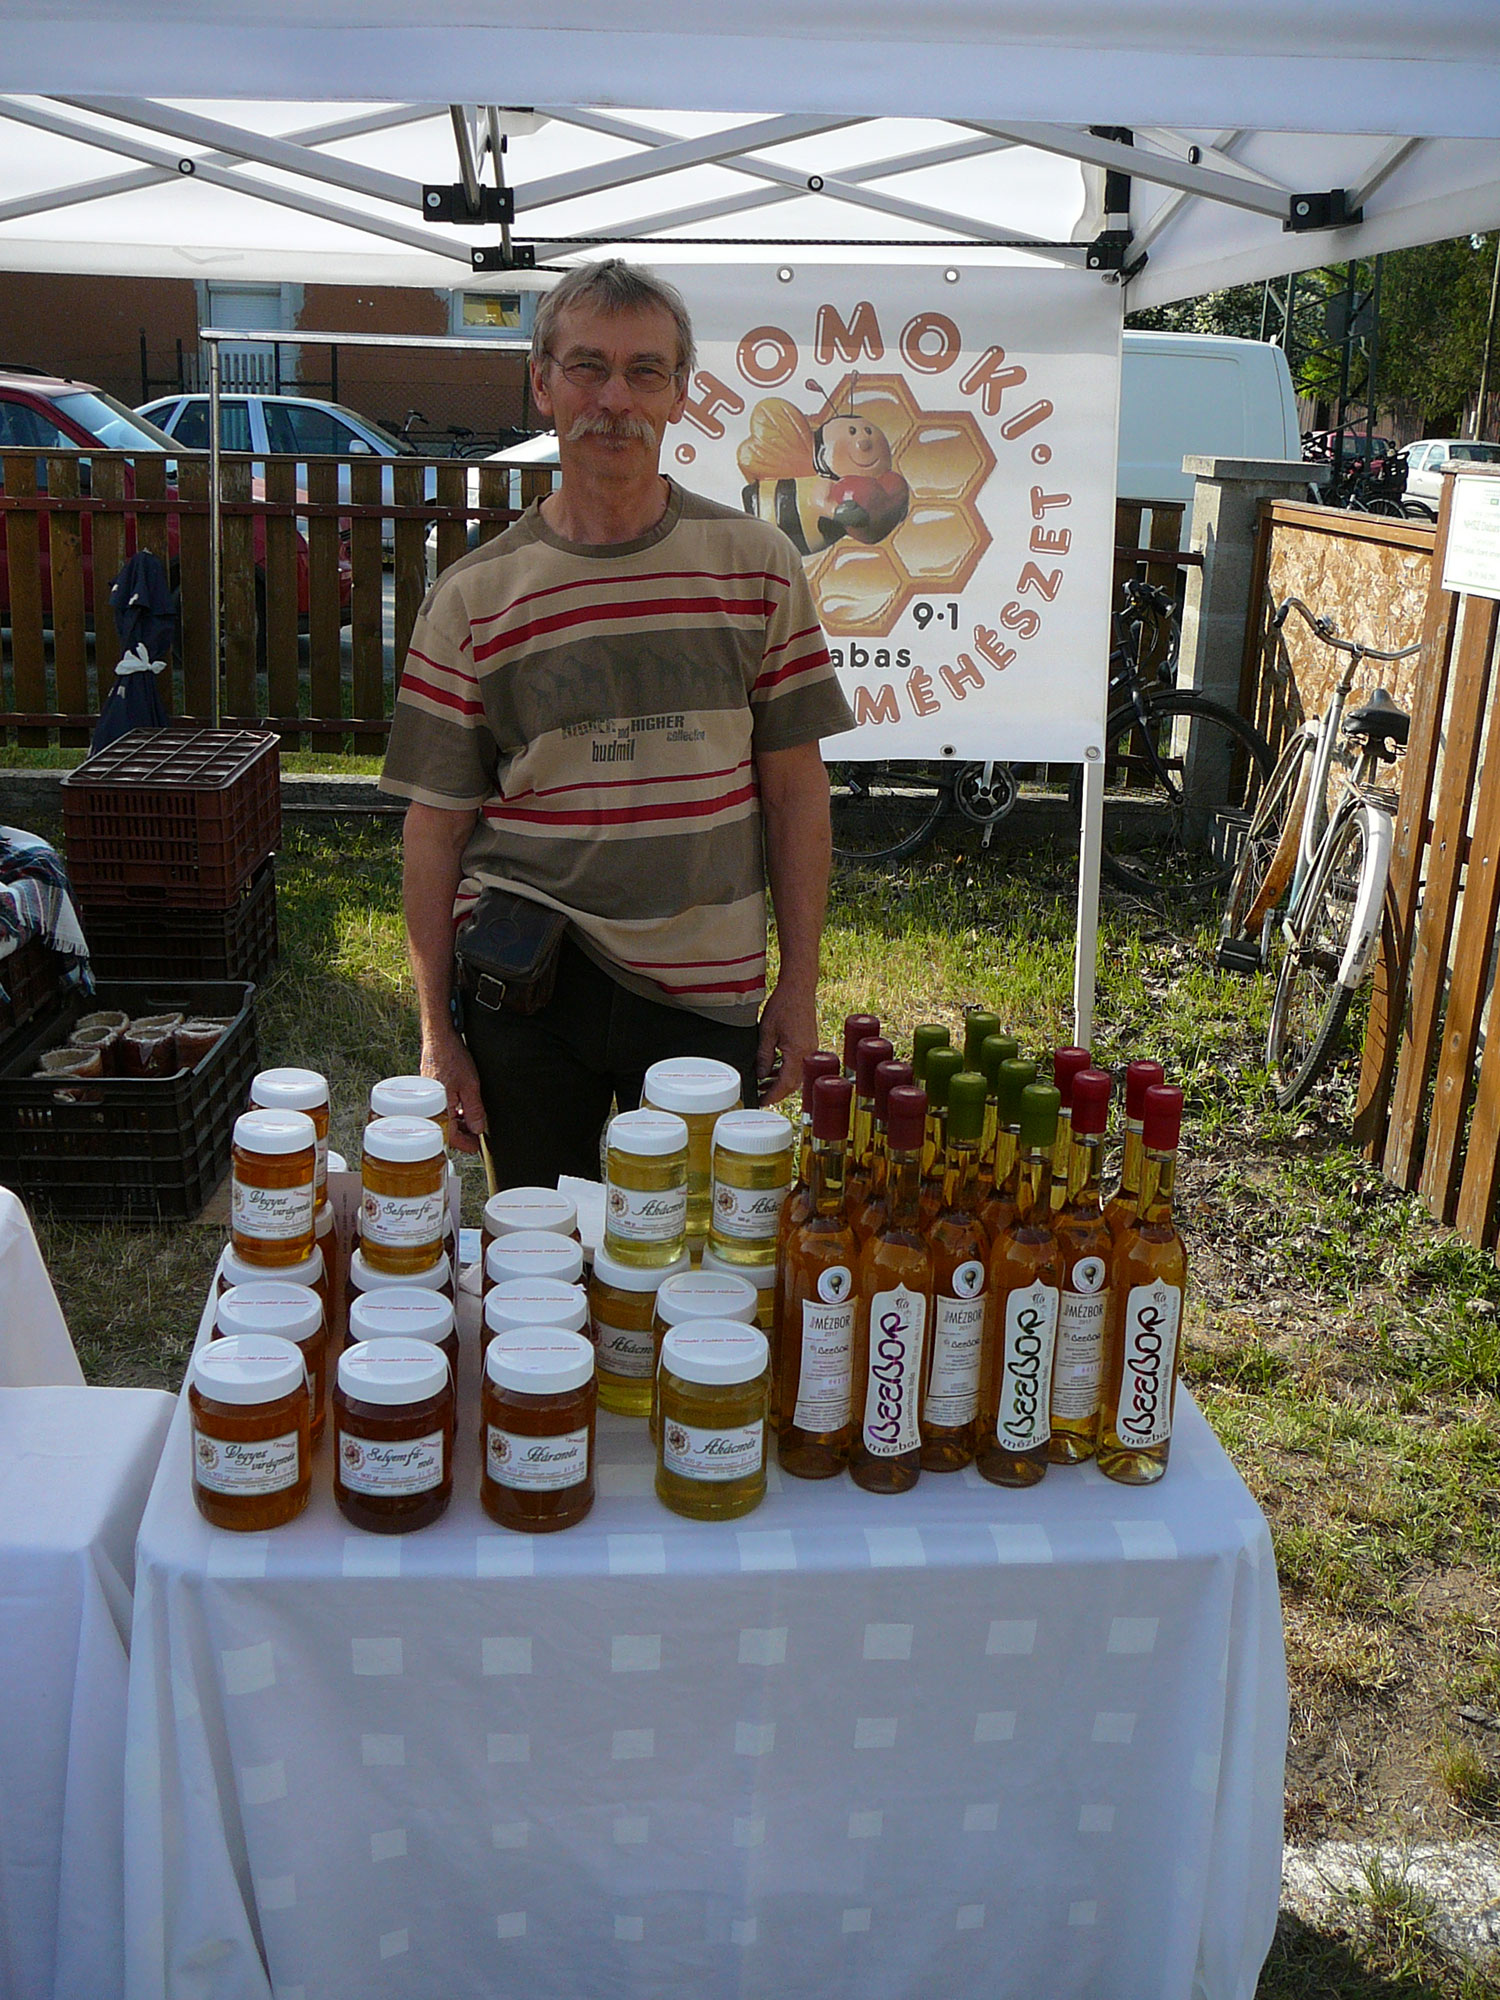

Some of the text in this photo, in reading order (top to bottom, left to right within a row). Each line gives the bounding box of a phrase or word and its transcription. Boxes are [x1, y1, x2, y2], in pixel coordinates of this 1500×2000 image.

[682, 301, 1054, 440] HOMOKI
[854, 486, 1072, 726] MÉHÉSZET
[630, 715, 685, 732] HIGHER
[592, 738, 635, 762] budmil
[249, 1190, 288, 1211] Vegyes
[949, 1308, 982, 1325] MÉZBOR
[1069, 1303, 1104, 1319] MÉZBOR
[815, 1314, 850, 1331] MÉZBOR
[1002, 1431, 1050, 1449] mézbor
[1121, 1428, 1169, 1445] mézbor
[693, 1437, 756, 1455] Akácméz
[868, 1438, 919, 1454] mézbor
[224, 1445, 268, 1466] Vegyes
